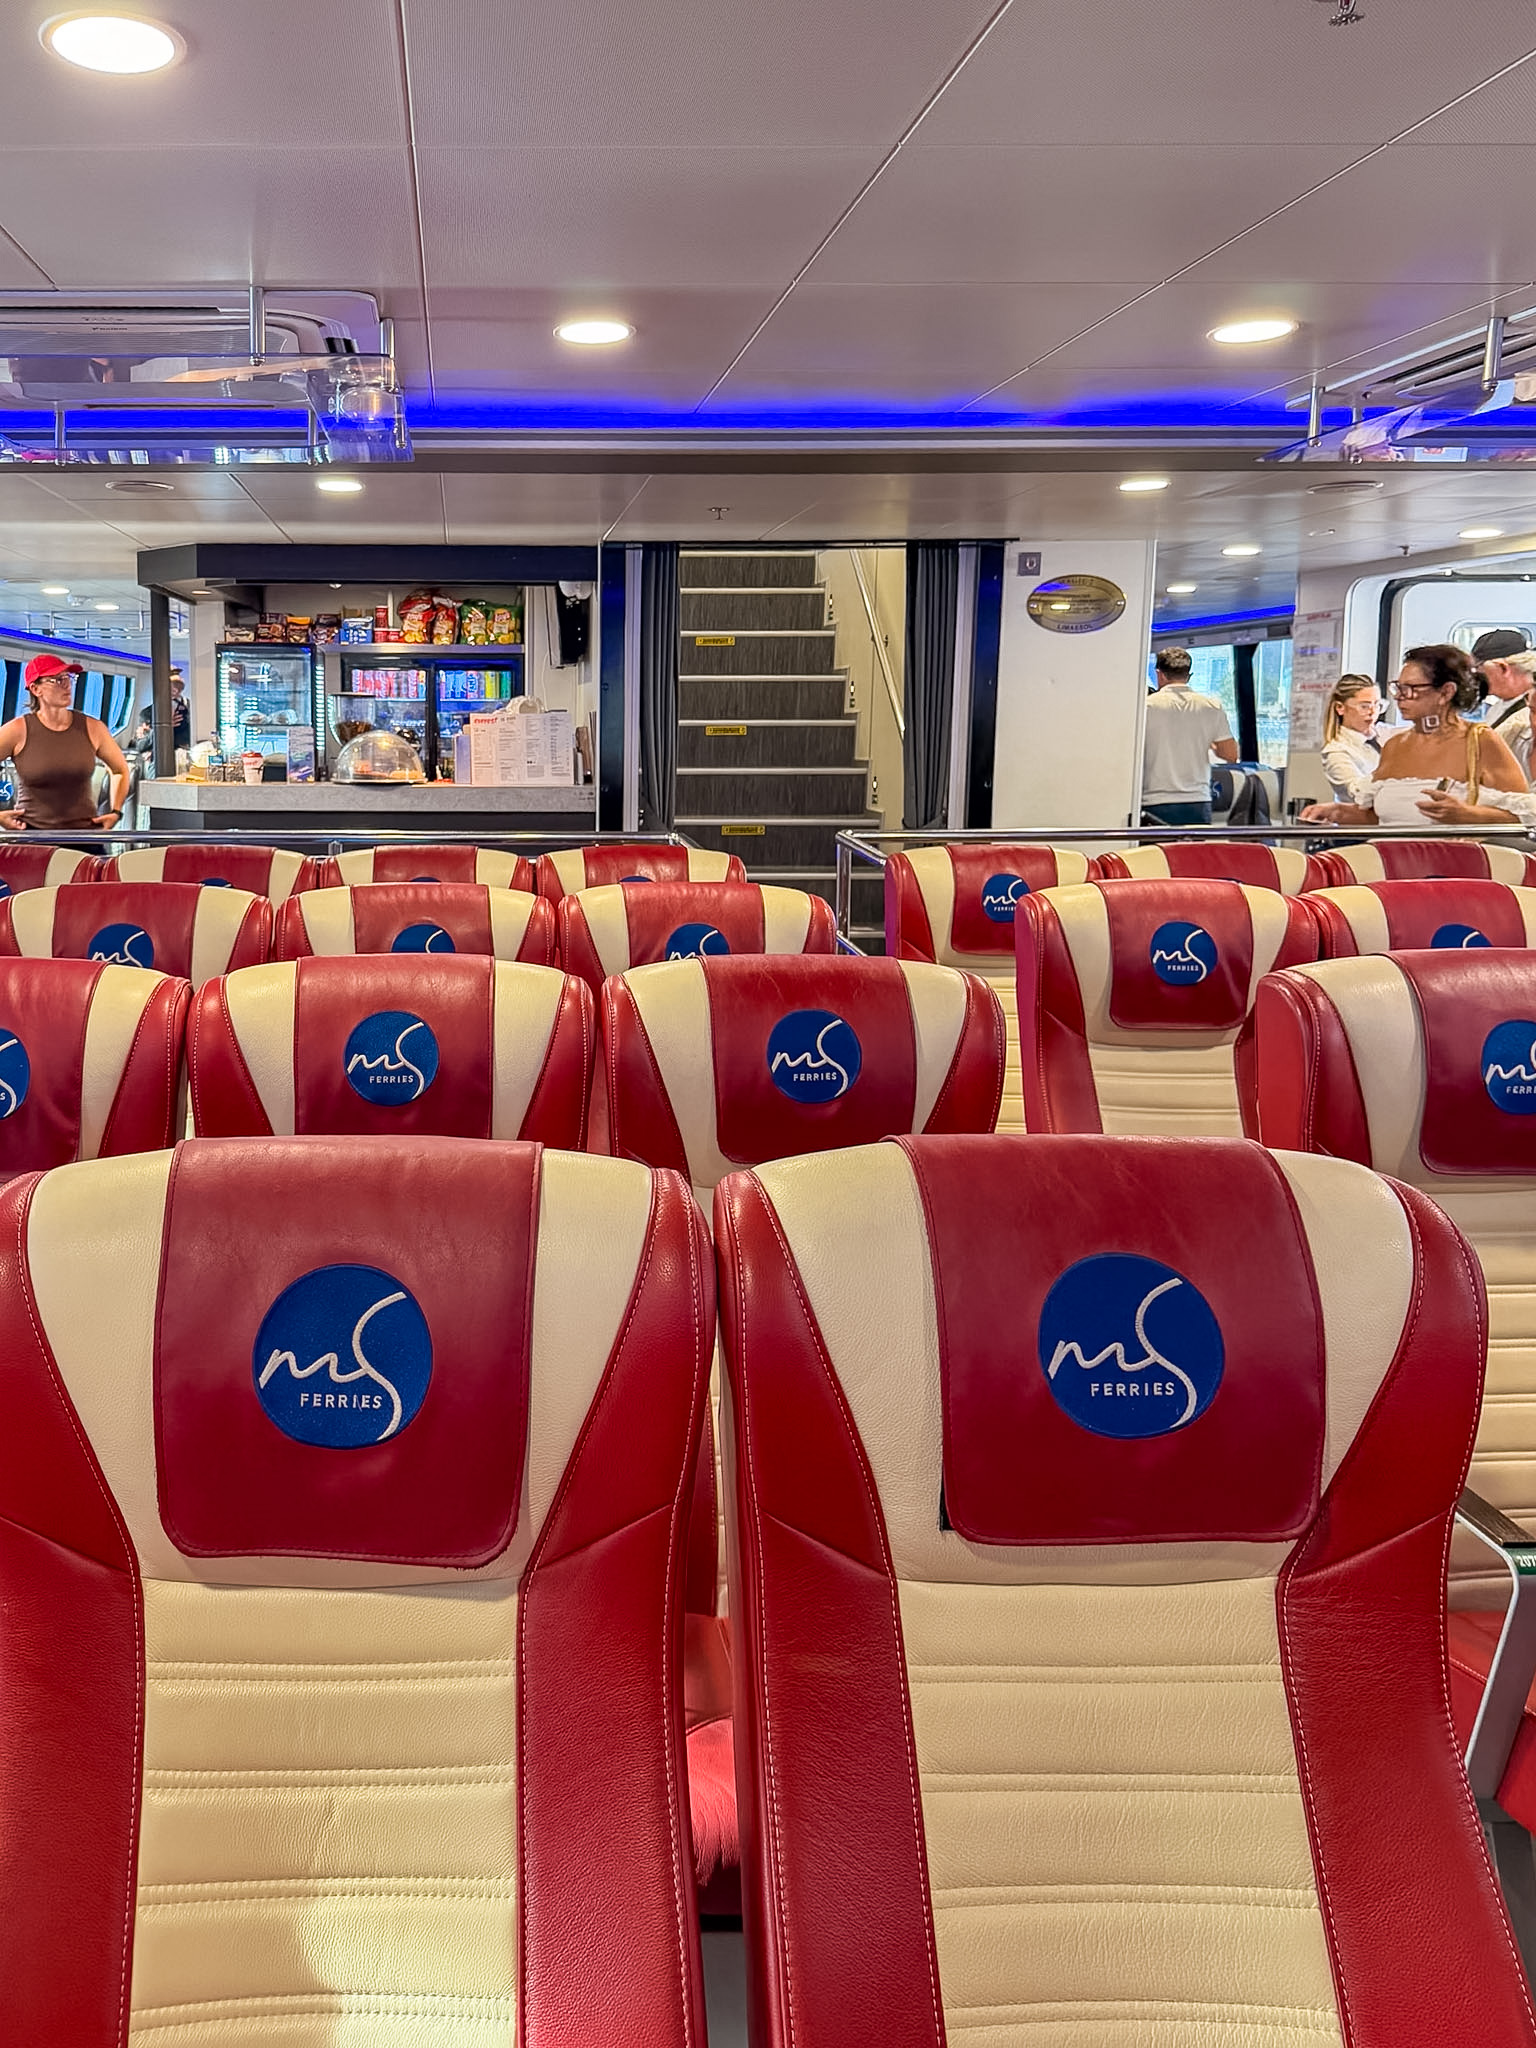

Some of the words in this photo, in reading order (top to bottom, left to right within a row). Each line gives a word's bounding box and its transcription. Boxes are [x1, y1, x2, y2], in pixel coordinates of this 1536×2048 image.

[369, 1074, 414, 1084] FERRIES
[793, 1072, 838, 1082] FERRIES
[1090, 1381, 1176, 1398] FERRIES
[300, 1392, 383, 1410] FERRIES
[1515, 1554, 1536, 1568] 207
